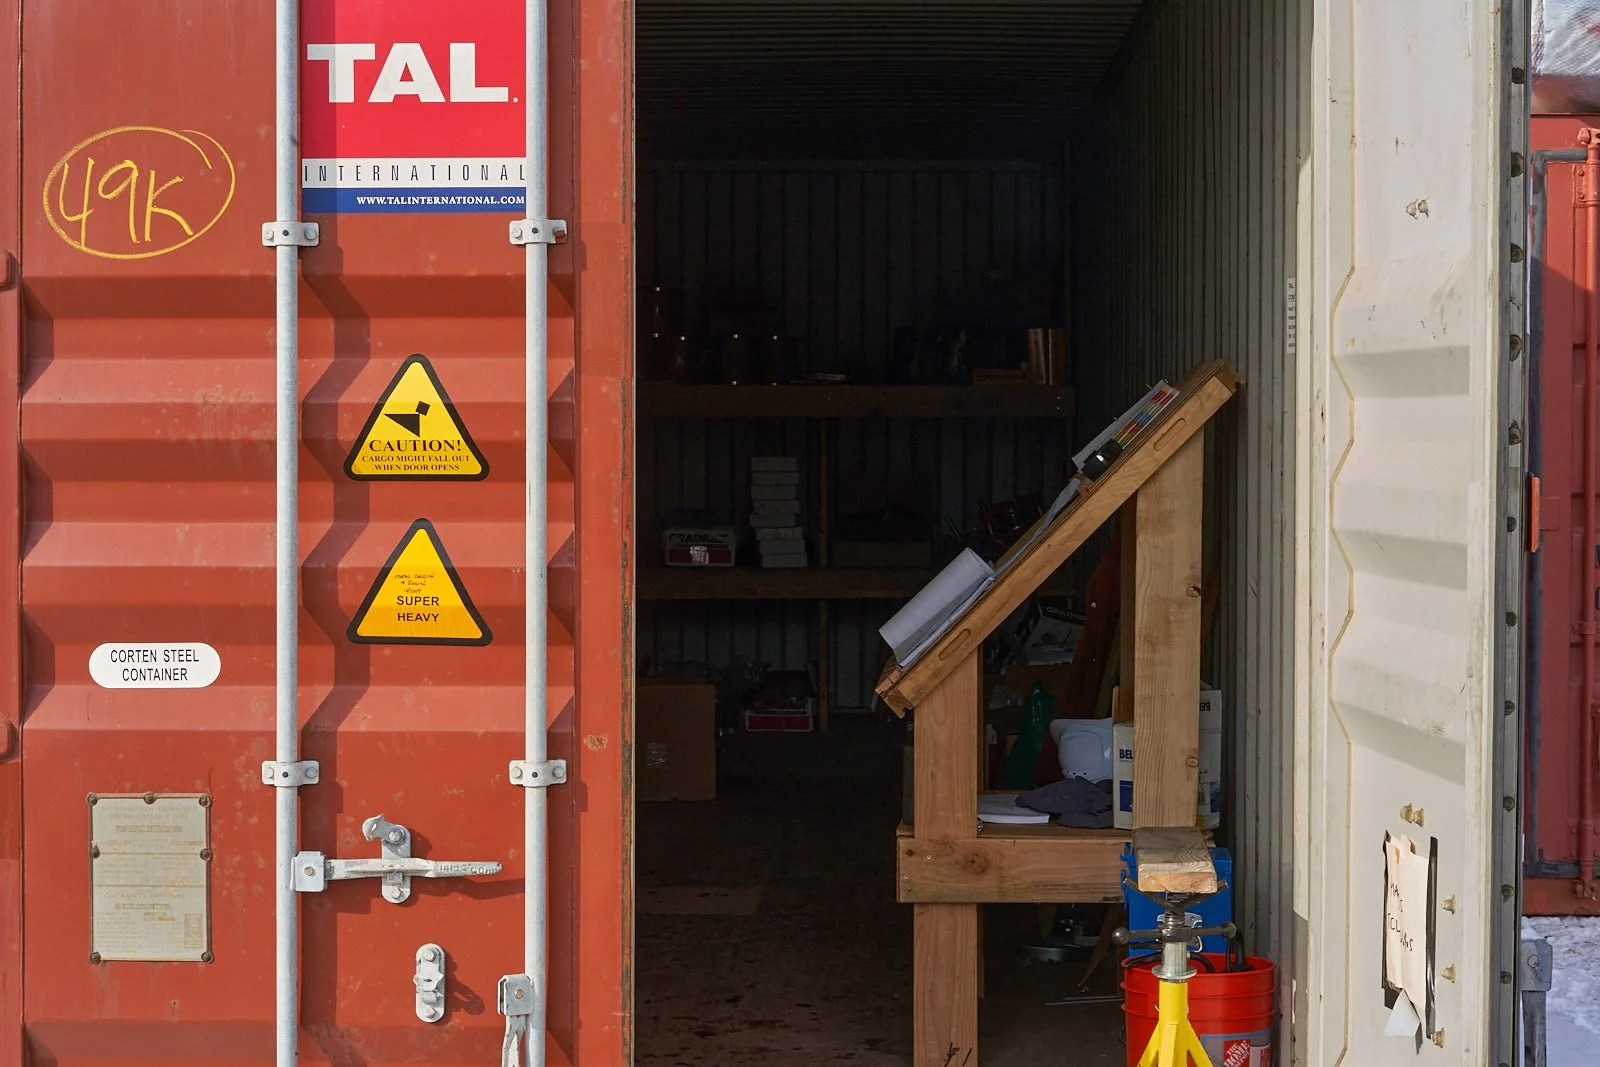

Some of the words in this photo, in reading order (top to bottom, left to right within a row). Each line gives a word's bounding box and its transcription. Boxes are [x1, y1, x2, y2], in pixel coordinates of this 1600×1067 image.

[304, 165, 527, 182] INTERNATIONAL
[60, 157, 194, 250] 49K
[356, 195, 525, 206] WWW.TALINTERNATIONAL.COM
[369, 439, 462, 452] CAUTION!
[396, 595, 440, 607] SUPER
[397, 612, 440, 622] HEAVY
[110, 649, 157, 663] CORTEN
[163, 649, 199, 663] STEEL
[122, 667, 188, 682] CONTAINER
